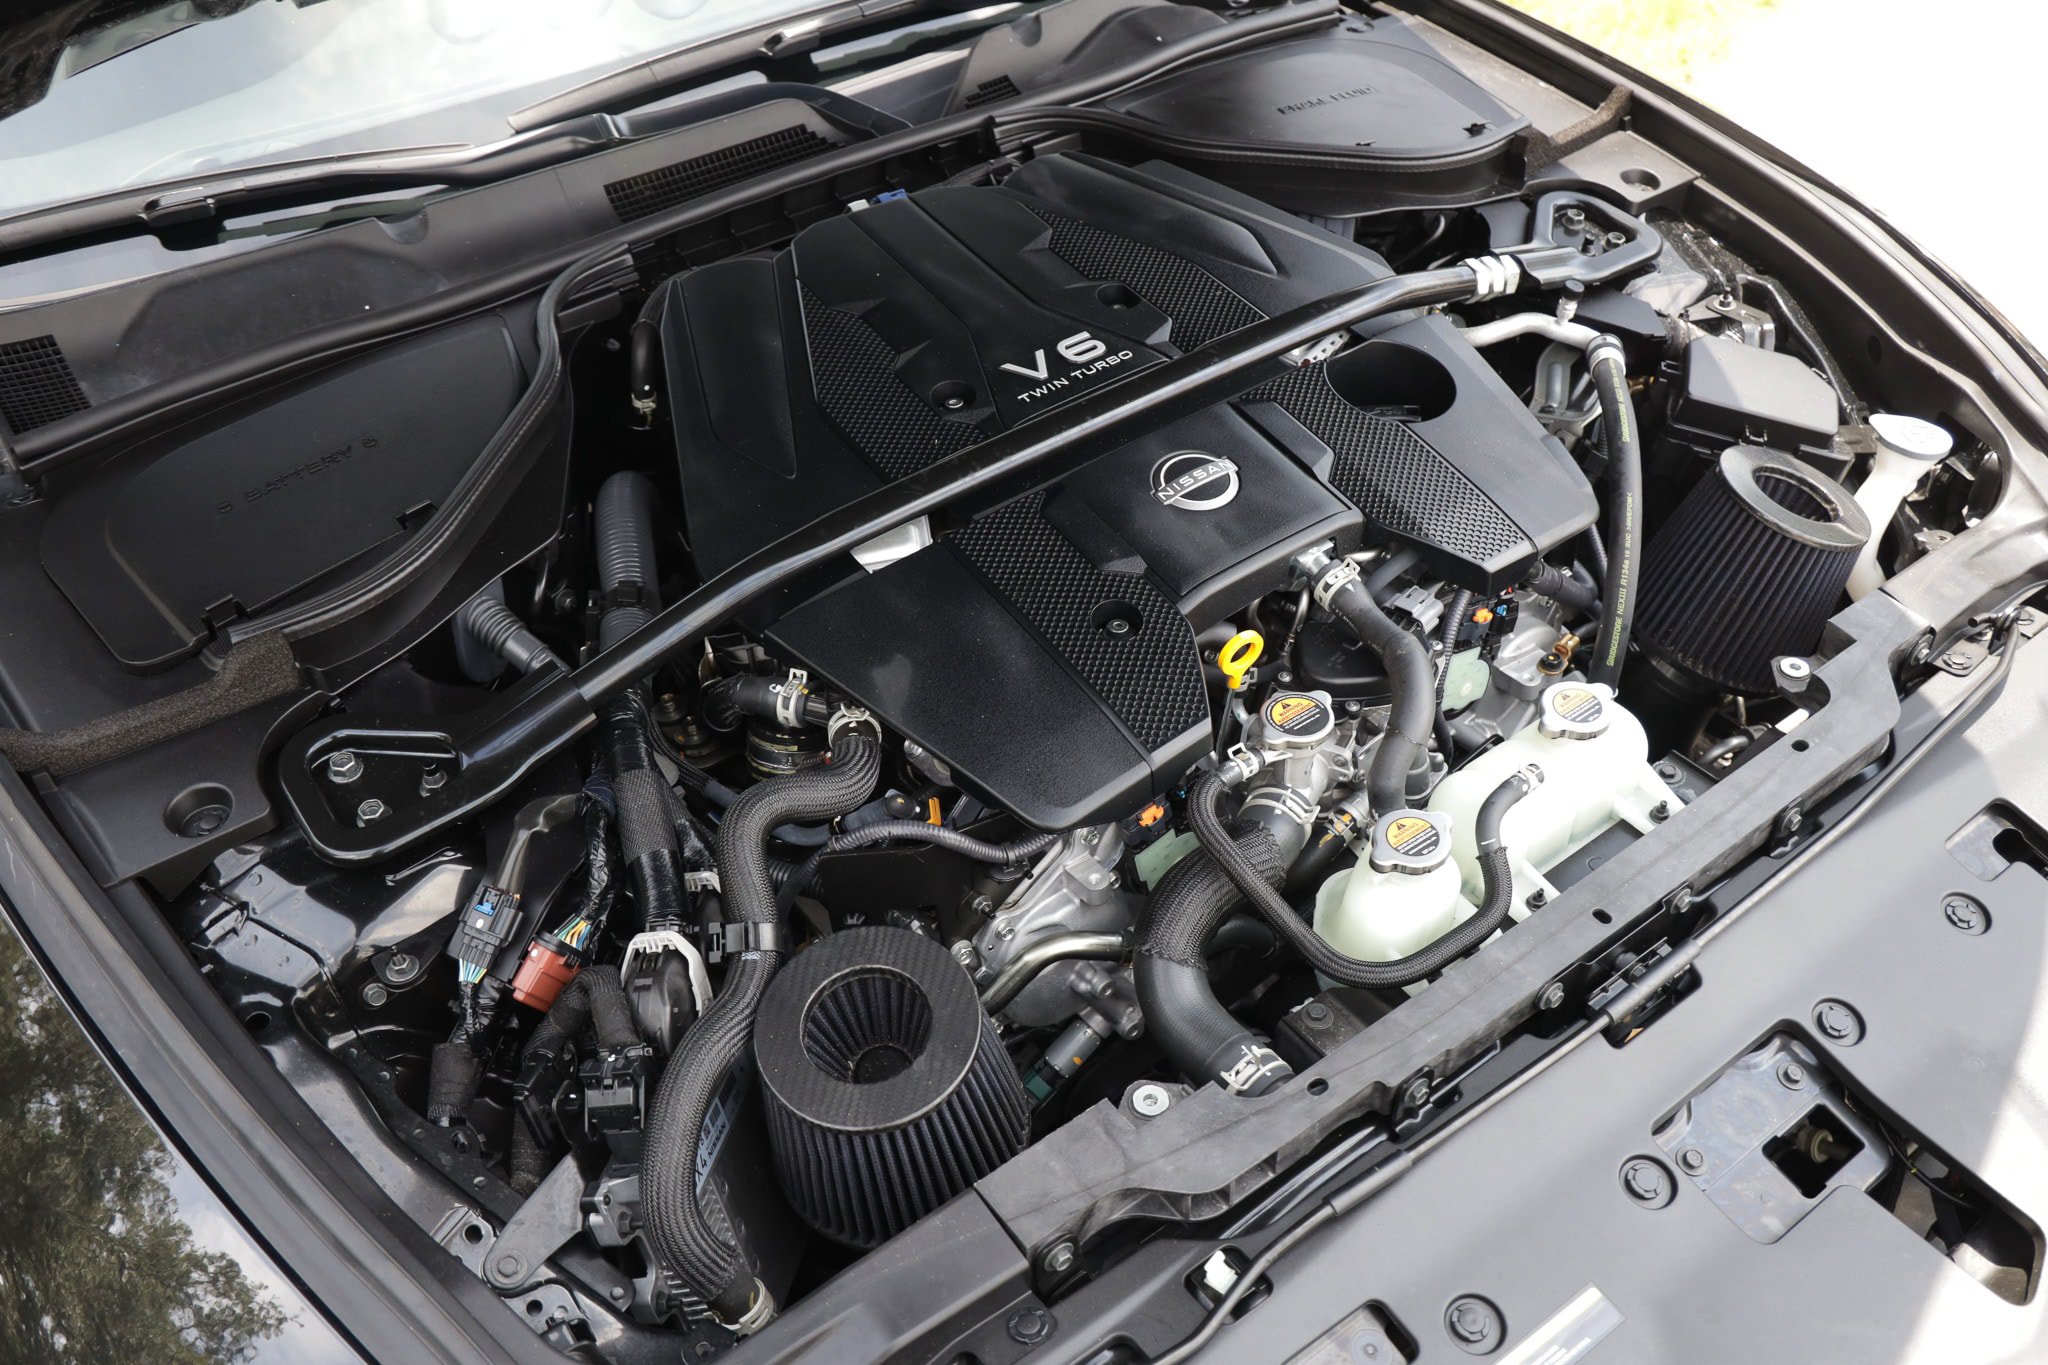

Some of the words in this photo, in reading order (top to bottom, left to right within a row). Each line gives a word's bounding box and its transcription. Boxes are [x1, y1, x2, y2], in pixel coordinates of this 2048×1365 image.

[999, 331, 1106, 380] V6
[1017, 377, 1069, 402] TWIN
[1070, 350, 1133, 379] TURBO
[246, 445, 351, 502] BATTERY
[1157, 460, 1234, 501] NISSAN
[1606, 616, 1622, 667] BRIDGESTONE
